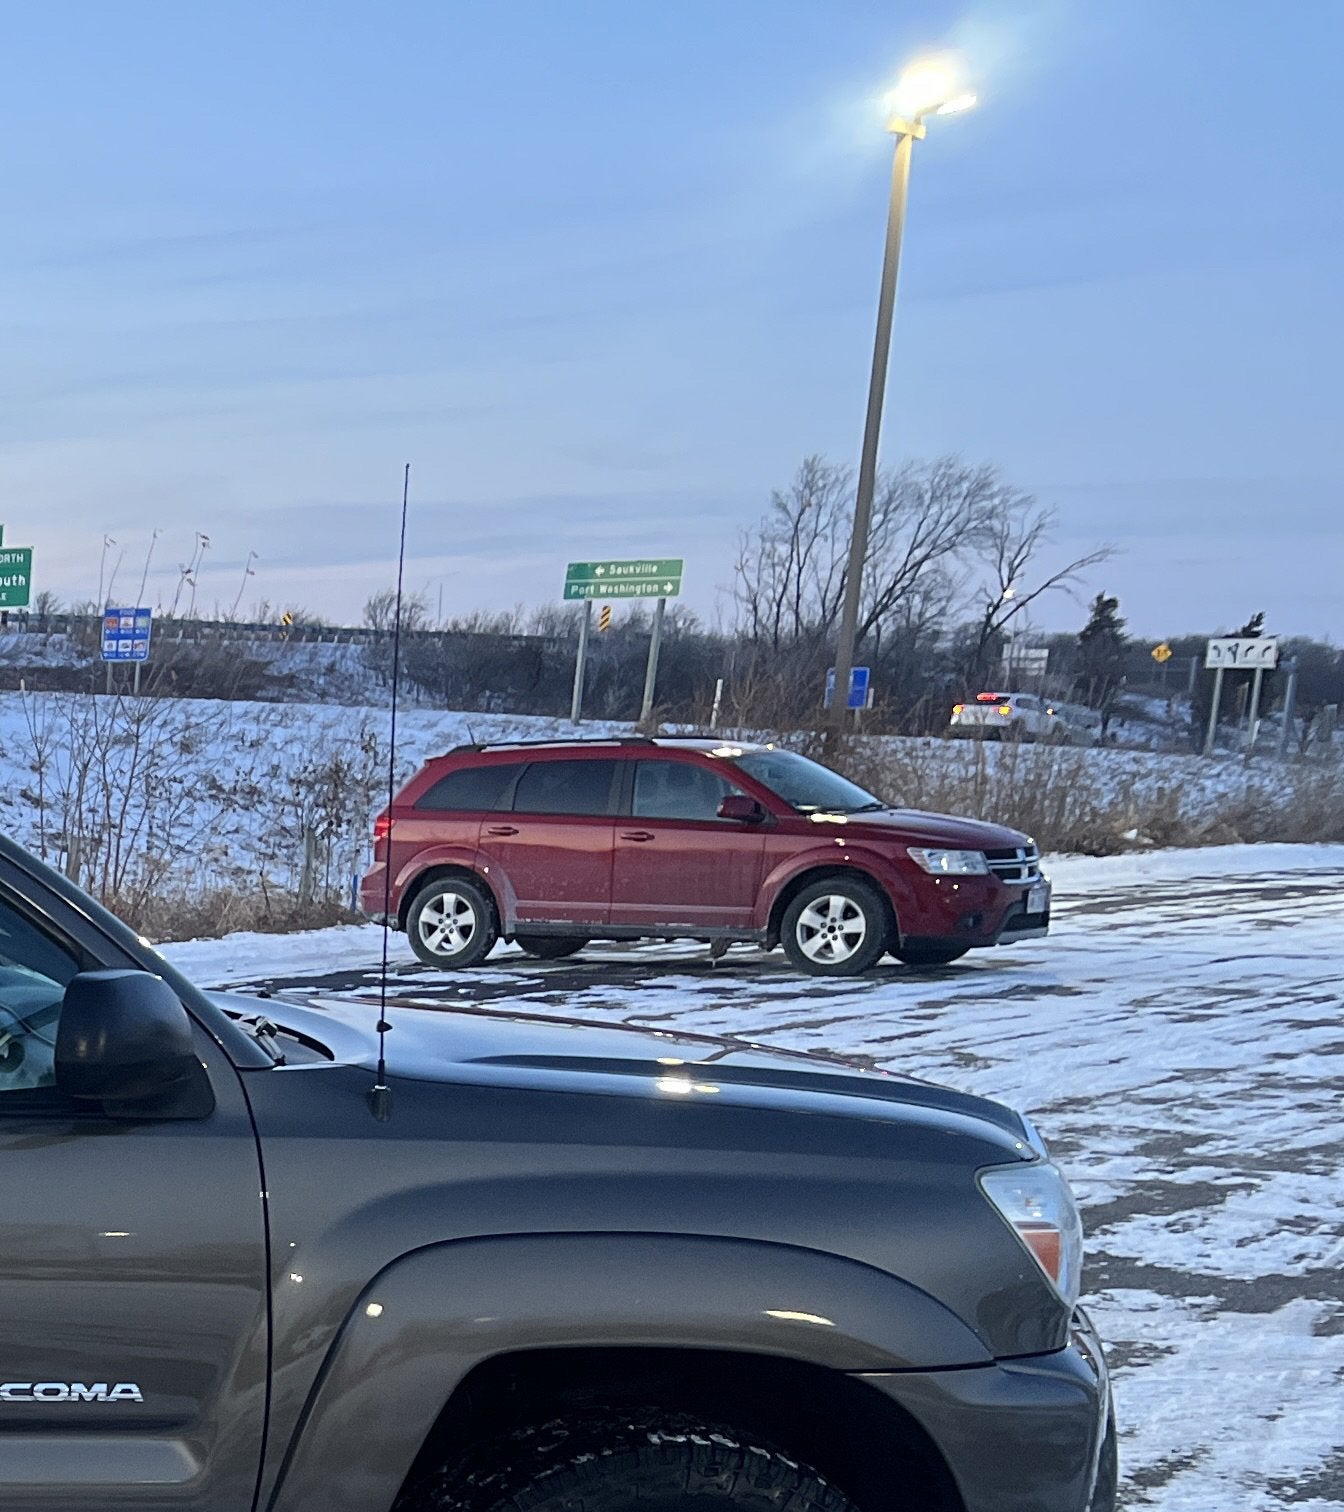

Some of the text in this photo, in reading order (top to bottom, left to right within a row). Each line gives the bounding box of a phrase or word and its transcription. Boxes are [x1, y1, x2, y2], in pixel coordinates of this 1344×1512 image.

[609, 564, 658, 575] Saukville
[570, 583, 659, 596] Port Washington
